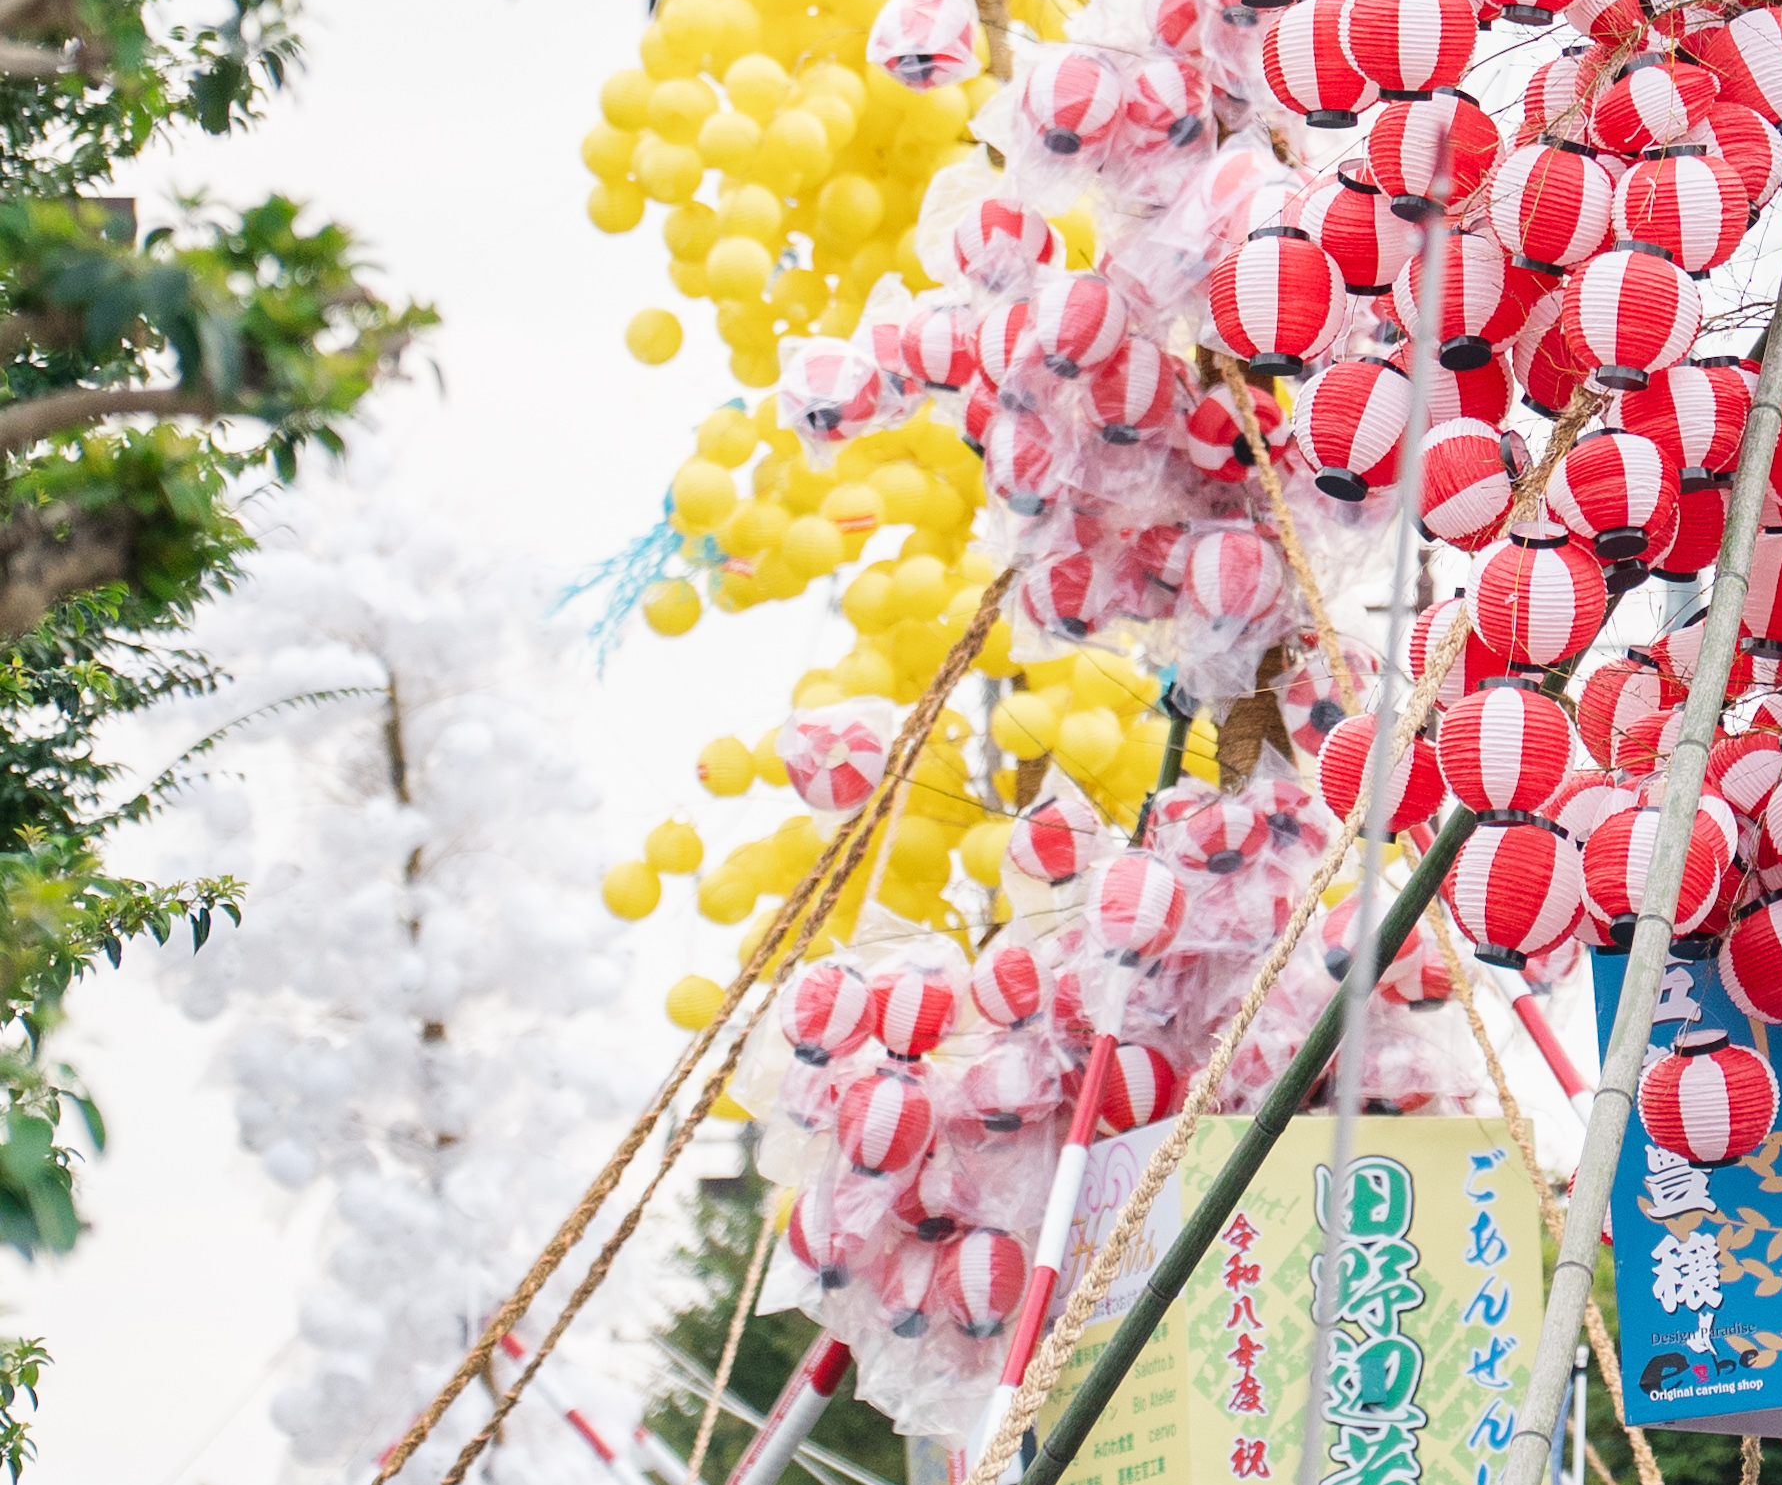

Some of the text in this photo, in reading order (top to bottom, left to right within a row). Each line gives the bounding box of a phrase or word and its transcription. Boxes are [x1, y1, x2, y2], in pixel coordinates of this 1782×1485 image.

[1222, 1213, 1266, 1414] 令和八年度
[1651, 1322, 1756, 1345] Design Paradise
[1650, 1379, 1764, 1402] Original carving shop
[1231, 1438, 1271, 1479] 祝
